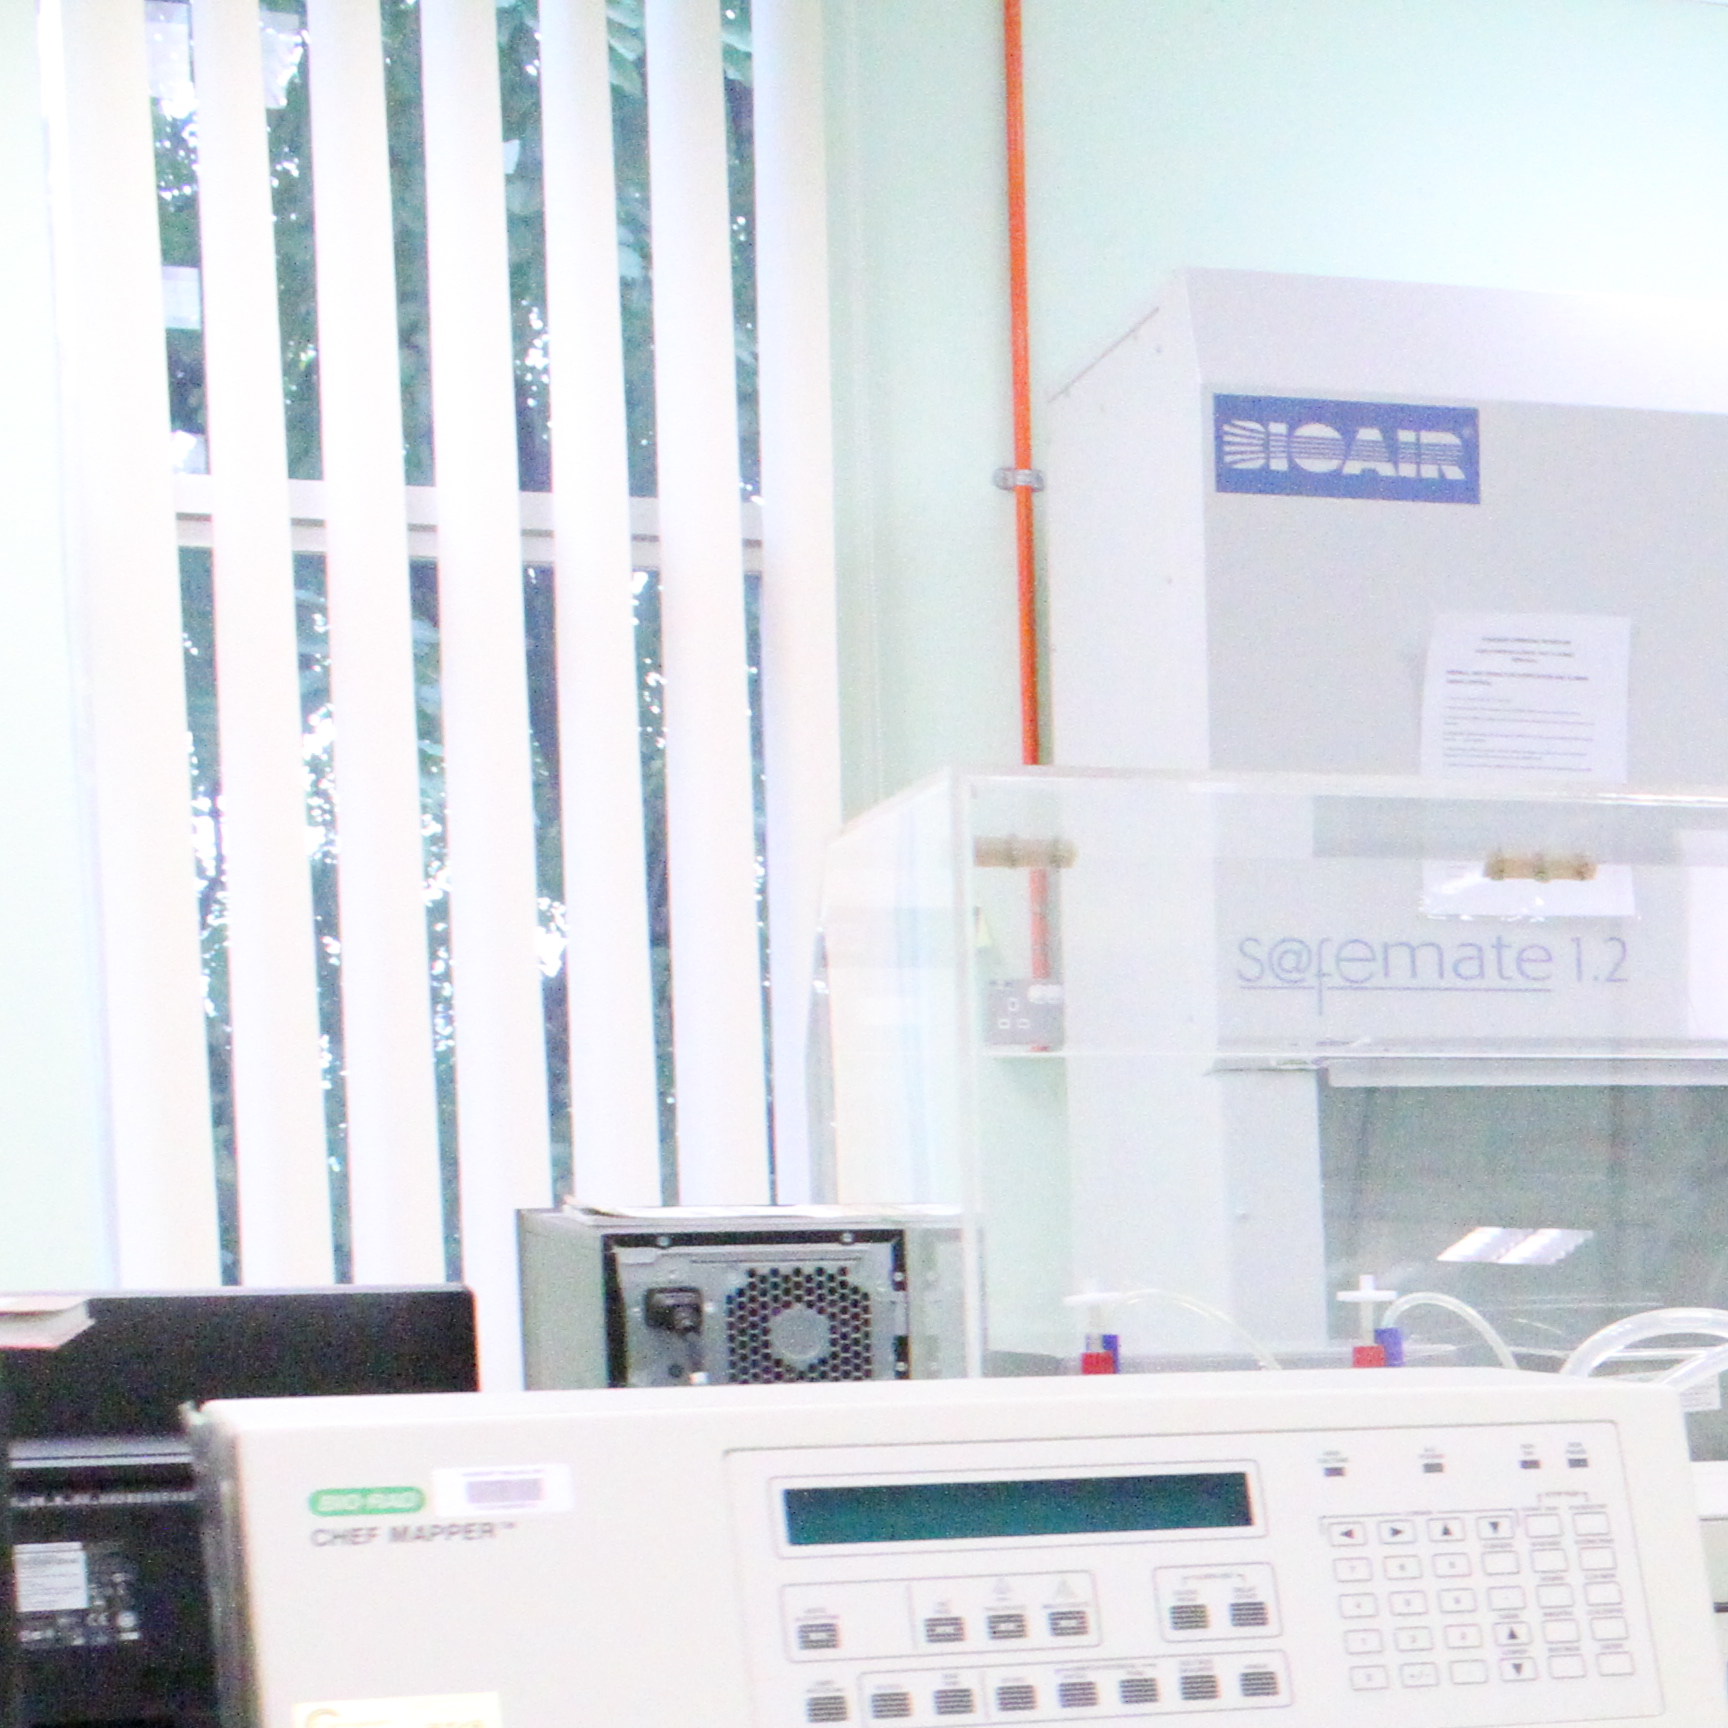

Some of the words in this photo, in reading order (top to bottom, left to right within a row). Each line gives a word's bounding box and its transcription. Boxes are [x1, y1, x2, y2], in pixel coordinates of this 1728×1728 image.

[1222, 420, 1466, 480] BIOAIR
[1572, 936, 1629, 983] 1.2
[310, 1528, 379, 1547] CHEF
